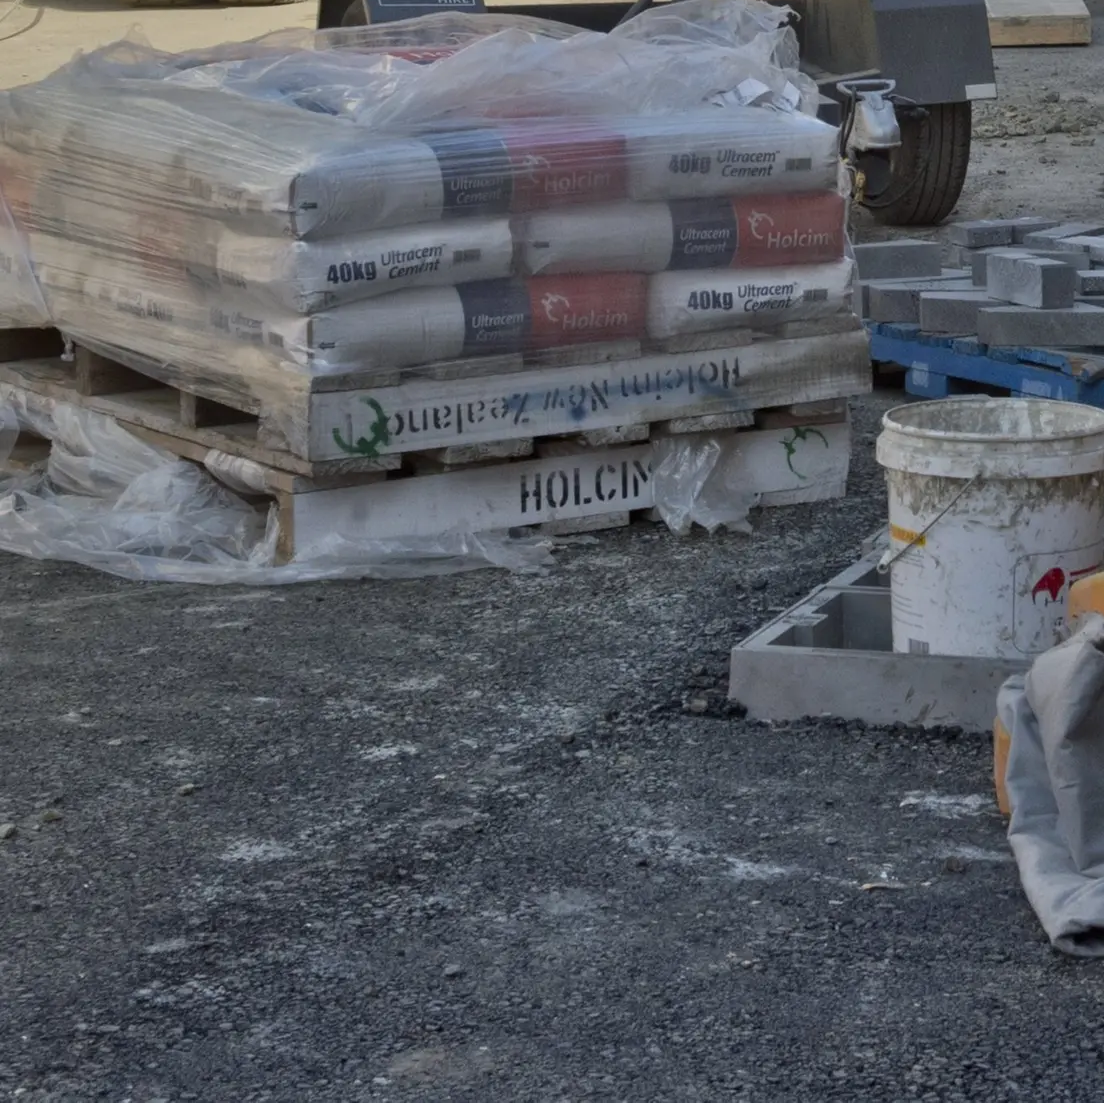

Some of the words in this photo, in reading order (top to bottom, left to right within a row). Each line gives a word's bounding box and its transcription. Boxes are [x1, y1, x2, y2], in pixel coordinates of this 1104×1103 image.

[668, 152, 711, 174] 40kg
[722, 164, 774, 177] Cement
[544, 169, 611, 193] Holcim
[680, 227, 731, 241] Ultracem
[766, 227, 831, 249] Holcim
[380, 246, 443, 267] Ultracem
[683, 241, 727, 254] Cement
[327, 259, 377, 284] 40kg
[388, 258, 441, 280] Cement
[687, 289, 734, 311] 40kg
[743, 297, 793, 313] Cement
[471, 312, 525, 329] Ultracem
[562, 309, 629, 331] Holcim
